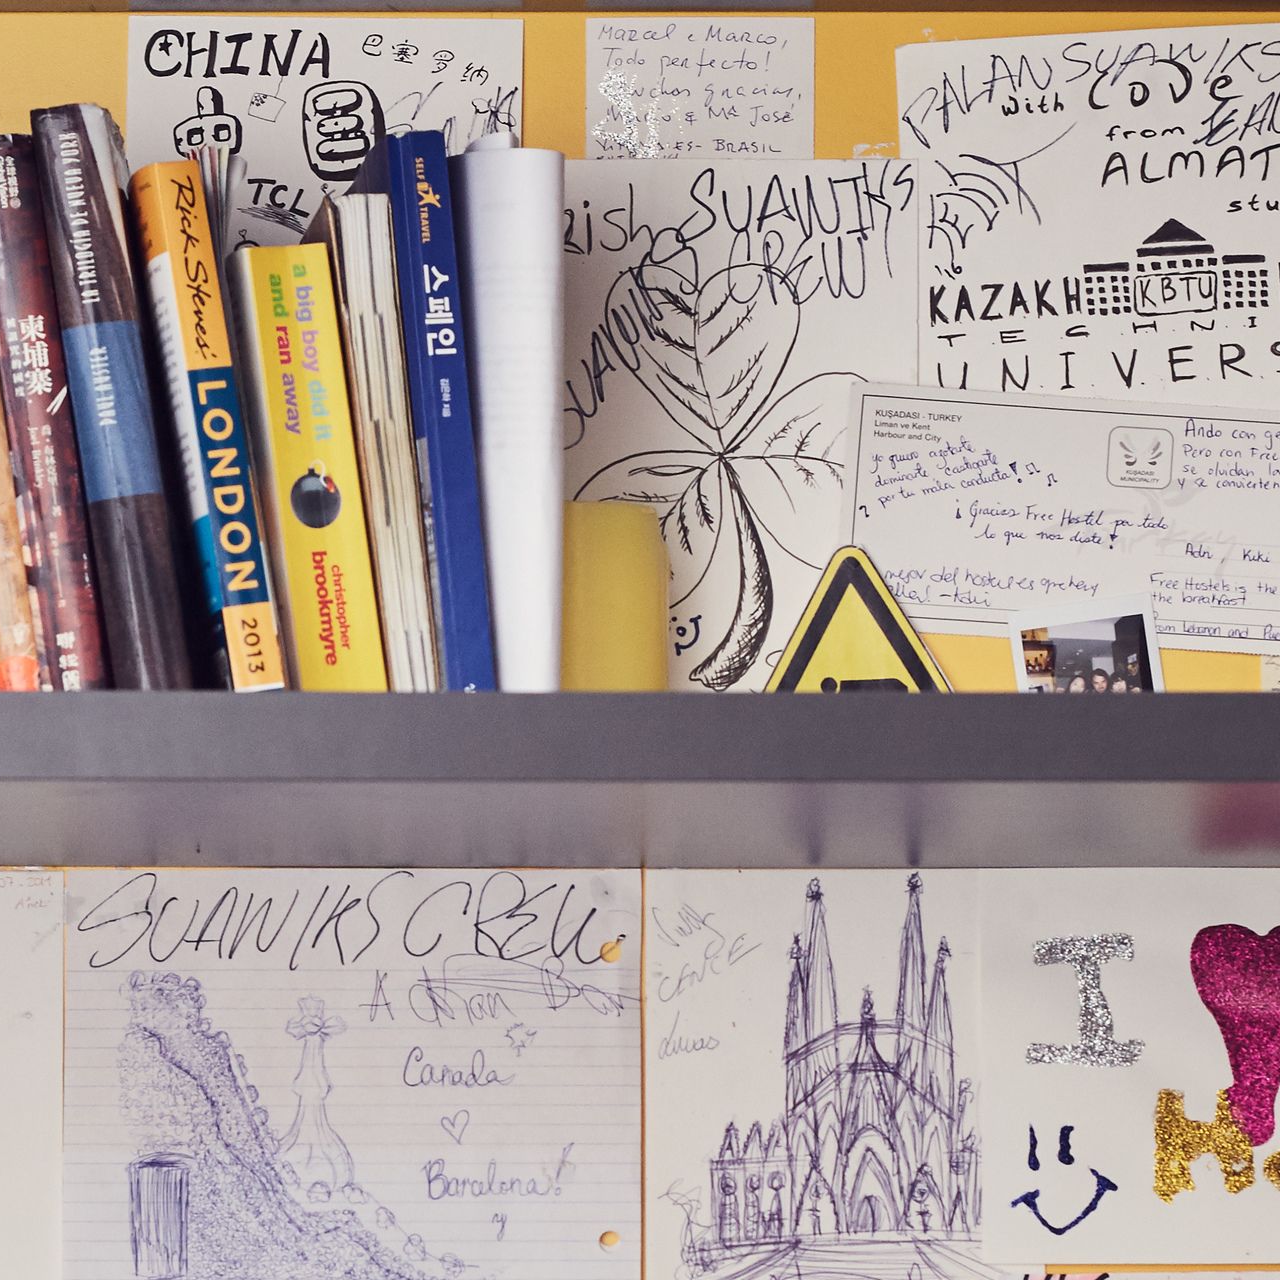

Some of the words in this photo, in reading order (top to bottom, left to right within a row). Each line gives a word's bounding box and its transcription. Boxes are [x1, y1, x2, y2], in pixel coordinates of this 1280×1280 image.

[143, 28, 333, 80] CHINA
[58, 131, 81, 168] YORK
[713, 138, 782, 153] BRASIL
[1105, 125, 1186, 142] from
[414, 156, 426, 181] SELF
[63, 168, 88, 212] NUEVA
[246, 177, 313, 219] TCL
[70, 212, 89, 231] DE
[170, 175, 200, 254] Rick
[419, 206, 432, 244] TRAVEL
[292, 263, 308, 278] a
[81, 288, 101, 305] LA
[268, 273, 290, 319] and
[295, 285, 314, 324] big
[422, 263, 458, 357] 스페인
[928, 276, 1082, 327] KAZAKH
[1139, 275, 1213, 307] KBTU
[19, 314, 53, 397] 柬埔寨
[275, 325, 294, 366] ran
[301, 329, 321, 374] boy
[282, 372, 301, 435] away
[307, 380, 330, 417] did
[875, 409, 920, 420] KUŞADASI
[928, 412, 962, 423] TURKEY
[314, 420, 333, 441] it
[873, 430, 907, 440] Harbour
[908, 433, 923, 441] and
[925, 434, 942, 443] City
[874, 420, 898, 428] Liman
[912, 422, 931, 431] Kent
[196, 380, 258, 592] LONDON
[238, 617, 268, 675] 2013
[311, 550, 338, 666] brookmyre
[331, 564, 351, 651] christopher
